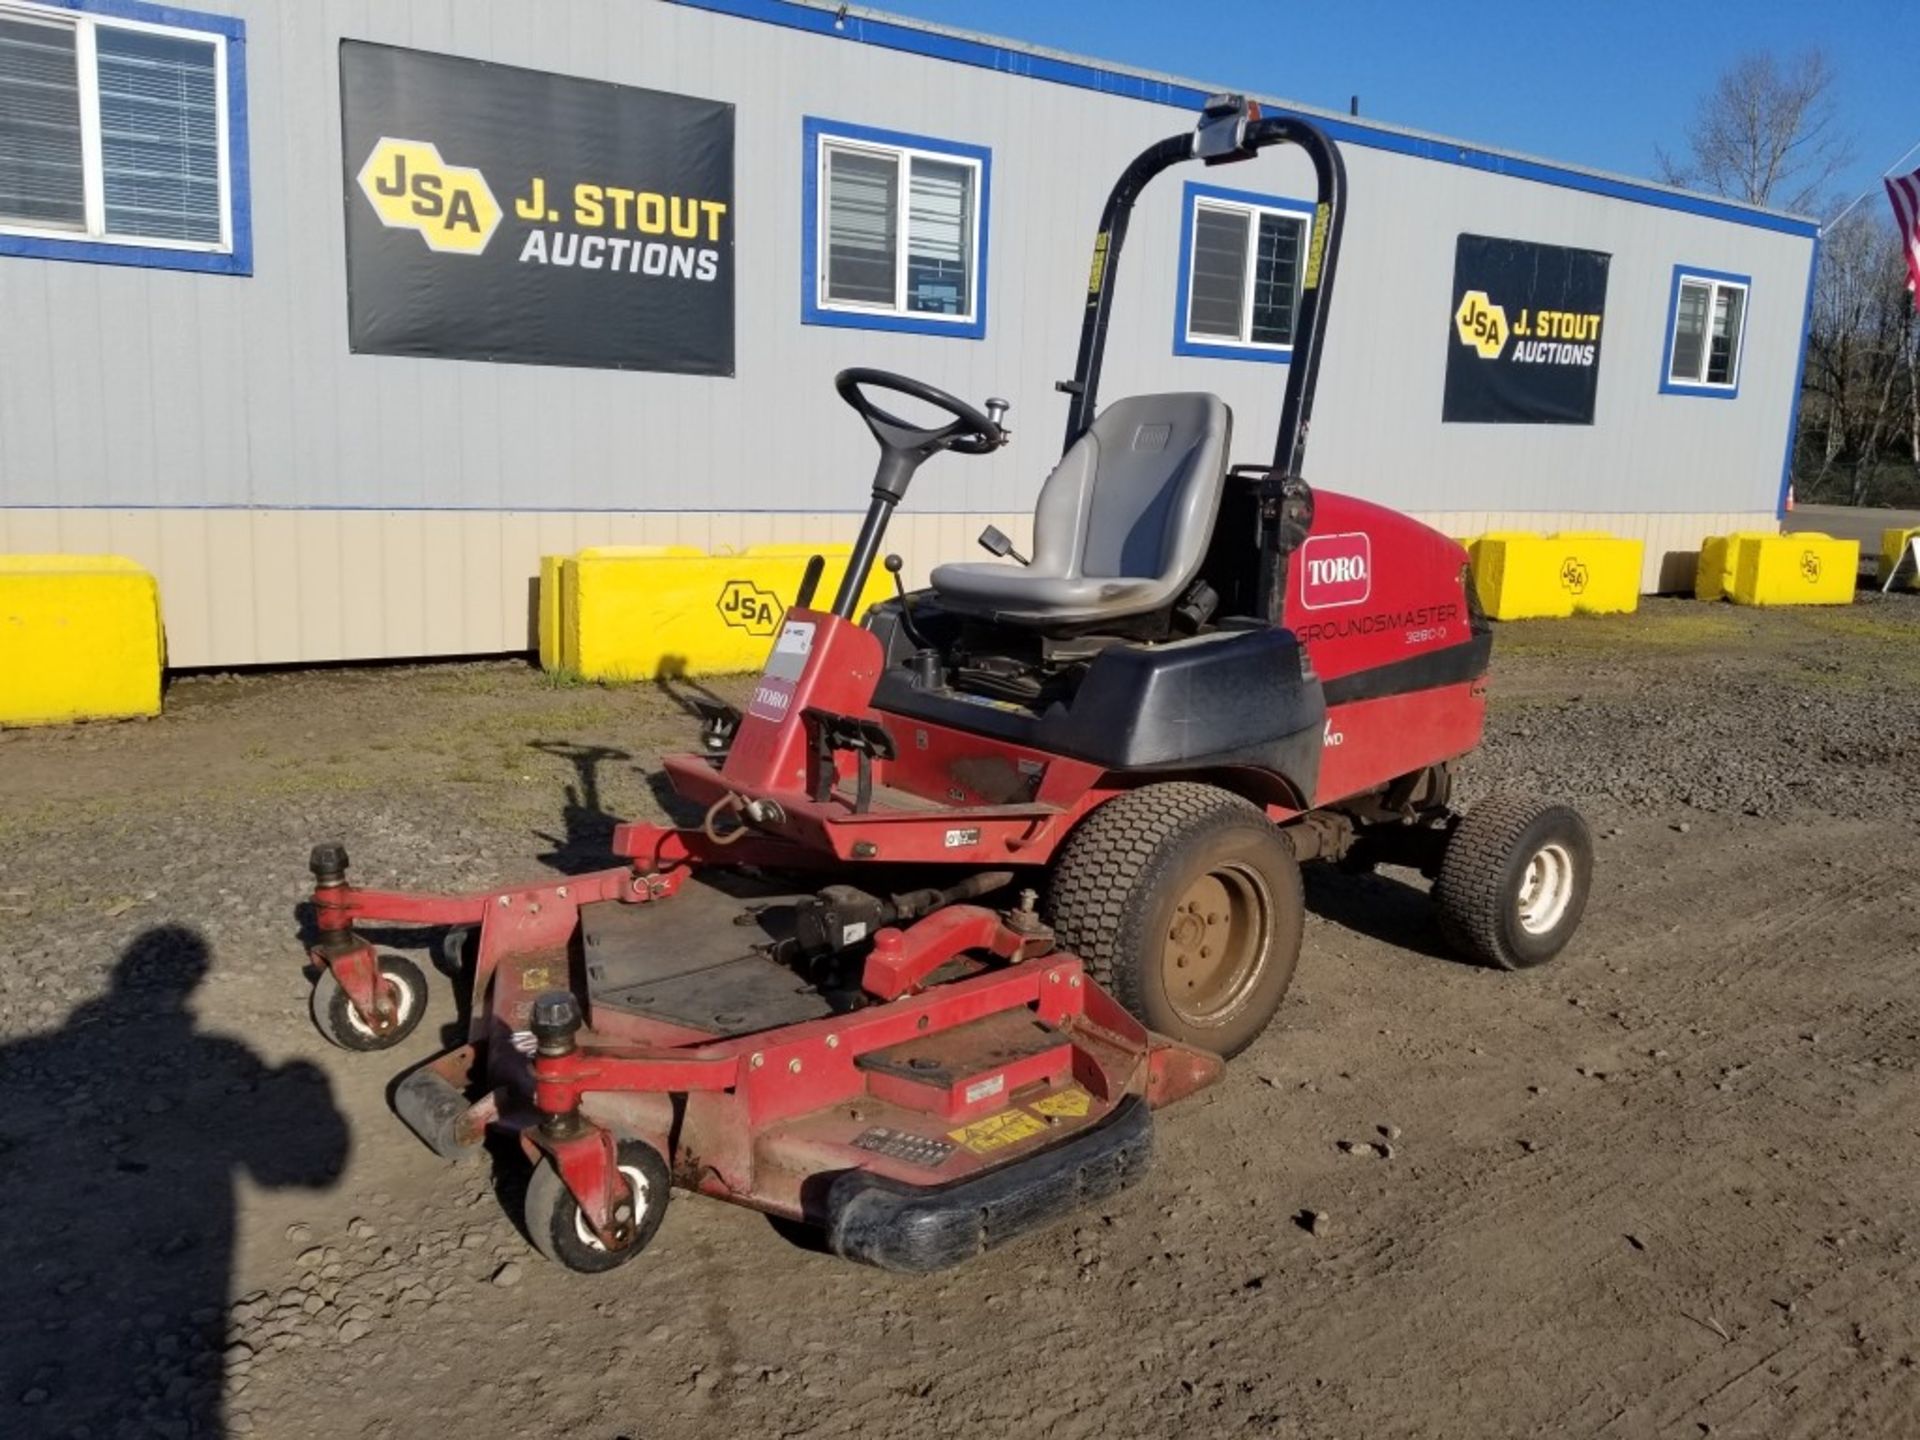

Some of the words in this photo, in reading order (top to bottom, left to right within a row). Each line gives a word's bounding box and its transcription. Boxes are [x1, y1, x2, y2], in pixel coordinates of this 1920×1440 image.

[376, 154, 481, 233] JSA
[515, 177, 559, 222] J.
[574, 184, 727, 241] STOUT
[518, 230, 719, 282] AUCTIONS
[1463, 301, 1499, 345] JSA
[1514, 309, 1530, 335] J.
[1536, 311, 1600, 340] STOUT
[1512, 341, 1595, 365] AUCTIONS
[1307, 554, 1366, 586] TORO
[1562, 562, 1584, 587] JSA
[725, 589, 773, 625] JSA
[1295, 604, 1458, 644] GROUNDSMASTER
[756, 687, 788, 708] TORO
